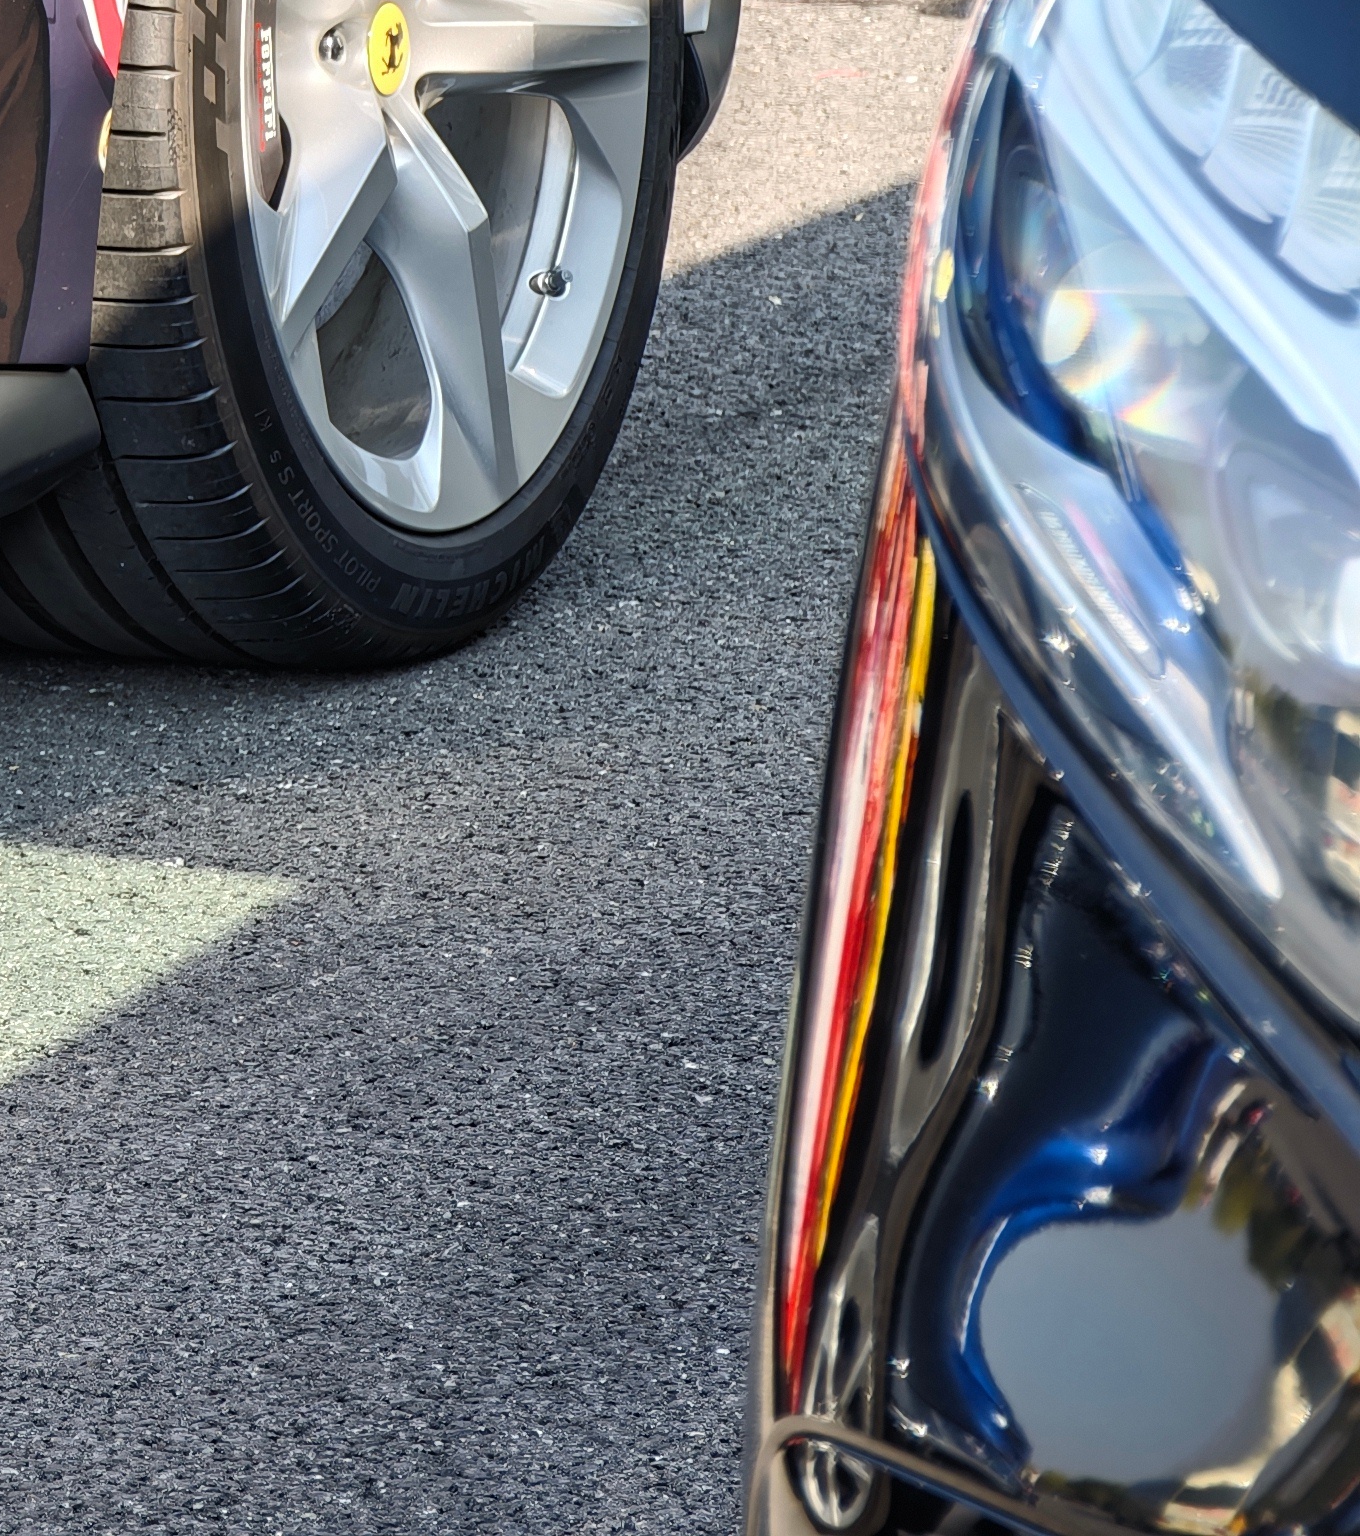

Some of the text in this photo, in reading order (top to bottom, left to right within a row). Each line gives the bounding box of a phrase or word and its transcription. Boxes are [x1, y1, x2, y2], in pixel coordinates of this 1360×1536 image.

[260, 26, 277, 142] Ferrari
[287, 491, 339, 553] SPORT
[334, 550, 380, 595] PILOT
